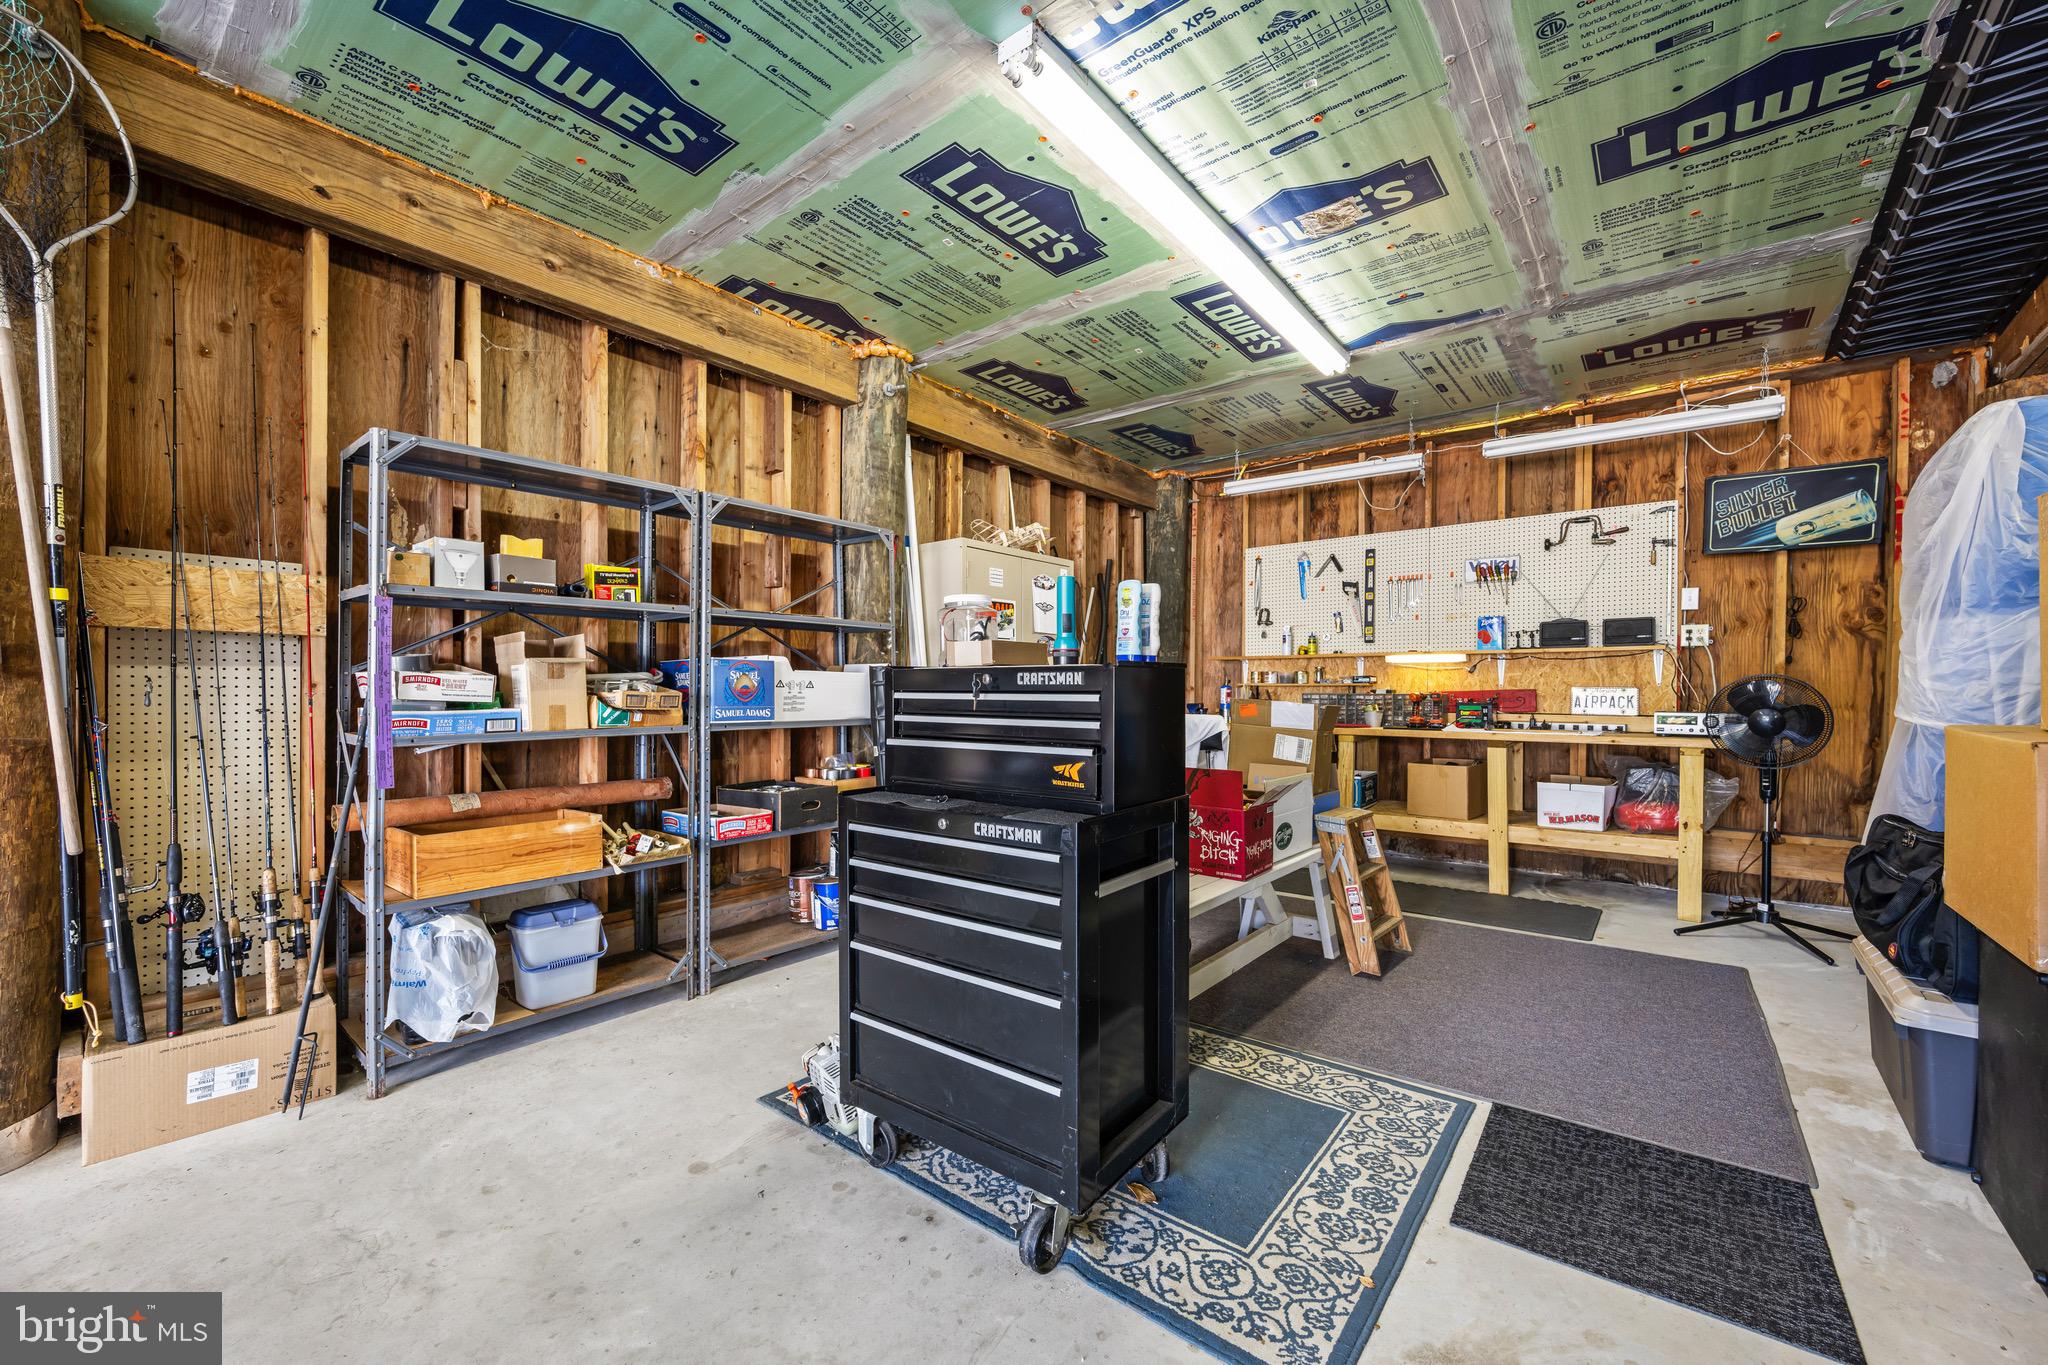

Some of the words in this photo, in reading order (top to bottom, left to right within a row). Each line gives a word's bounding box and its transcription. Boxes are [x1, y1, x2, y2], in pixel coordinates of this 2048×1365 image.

[856, 0, 870, 13] 5.0
[876, 16, 889, 29] 7.5
[891, 29, 907, 43] 10.0
[1182, 6, 1217, 32] XPS
[1577, 10, 1593, 20] CA
[1579, 14, 1607, 30] Florida
[1608, 0, 1646, 18] Product
[1580, 30, 1596, 40] MN
[1597, 21, 1620, 35] Dept.
[1621, 15, 1631, 23] of
[1632, 3, 1663, 20] Energy
[1581, 40, 1594, 50] UL
[1639, 0, 1696, 26] Classification
[708, 1, 742, 25] current
[742, 24, 789, 59] compliance
[788, 56, 833, 91] information.
[1274, 51, 1287, 61] 3.0
[1295, 40, 1309, 50] 3.8
[1317, 28, 1331, 39] 5.0
[1344, 15, 1356, 26] 7.5
[1363, 3, 1381, 15] 10.0
[1538, 35, 1569, 50] Intertek
[1105, 62, 1143, 86] Extruded
[1143, 35, 1194, 66] Polystyrene
[1194, 10, 1240, 39] Insulation
[1562, 59, 1578, 70] Go
[1580, 54, 1594, 63] To
[346, 52, 401, 80] Minimum
[348, 47, 386, 67] ASTM
[388, 64, 398, 72] C
[426, 82, 452, 98] Type
[452, 95, 466, 103] IV
[425, 0, 698, 154] LOWE'S
[1568, 73, 1581, 82] FM
[337, 90, 350, 99] CA
[338, 66, 397, 97] Enhanced
[398, 94, 440, 117] R-Value
[340, 62, 378, 82] Above
[392, 84, 427, 104] Below
[428, 102, 461, 120] Grade
[462, 119, 522, 149] Applications
[1156, 84, 1207, 113] Applications
[1629, 44, 1932, 168] LOWE'S
[330, 103, 345, 111] MN
[377, 123, 401, 137] Energy
[334, 96, 360, 111] Florida
[360, 109, 390, 124] Product
[391, 121, 422, 138] Approval
[438, 100, 496, 130] Residential
[462, 78, 509, 106] Extruded
[510, 102, 564, 135] Polystyrene
[566, 131, 609, 158] Insulation
[609, 151, 636, 169] Board
[1230, 148, 1241, 159] for
[1241, 140, 1255, 151] the
[1255, 132, 1275, 145] most
[1275, 119, 1305, 136] current
[1305, 97, 1352, 122] compliance
[1353, 73, 1408, 100] information.
[1796, 119, 1836, 137] XPS
[379, 131, 423, 153] Classification
[569, 123, 601, 142] XPS
[1682, 161, 1730, 177] Extruded
[1730, 141, 1795, 164] Polystyrene
[1796, 123, 1854, 144] Insulation
[1856, 109, 1895, 125] Board
[302, 108, 318, 118] Go
[320, 115, 333, 123] To
[511, 198, 539, 214] current
[539, 210, 581, 231] compliance
[1600, 205, 1628, 216] ASTM
[1660, 188, 1685, 198] Type
[1677, 182, 1733, 201] Residential
[1702, 177, 1765, 199] Applications
[851, 200, 879, 217] Minimum
[858, 197, 878, 210] ASTM
[930, 161, 1080, 264] LOWE'S
[836, 209, 867, 230] Enhanced
[866, 227, 889, 241] R-Value
[842, 206, 862, 220] Above
[867, 220, 886, 234] Below
[885, 231, 903, 244] Grade
[847, 203, 883, 227] Commercial
[894, 230, 925, 249] Residential
[925, 216, 949, 233] Extruded
[1347, 231, 1372, 243] XPS
[1352, 233, 1387, 247] Insulation
[1388, 224, 1412, 235] Board
[982, 243, 1002, 256] XPS
[1191, 290, 1282, 354] LOWE'S
[1604, 318, 1784, 366] LOWE'S
[975, 366, 1071, 411] LOWE'S
[1316, 380, 1381, 421] LOWE'S
[1127, 424, 1191, 459] LOWE'S
[56, 486, 65, 529] FRABILL
[1715, 476, 1790, 518] SILVER
[1714, 490, 1798, 538] BULLET
[531, 587, 555, 595] VIONIC
[404, 675, 439, 684] SMIRNOFF
[1017, 672, 1083, 686] CRAFTSMAN
[715, 709, 744, 719] SAMUEL
[746, 708, 771, 718] ADAMS
[1574, 695, 1635, 709] AIRPACK
[392, 720, 425, 728] MIRNOFF
[974, 822, 1042, 844] CRAFTSMAN
[1198, 826, 1243, 852] RAGING
[1200, 845, 1238, 864] BITCH
